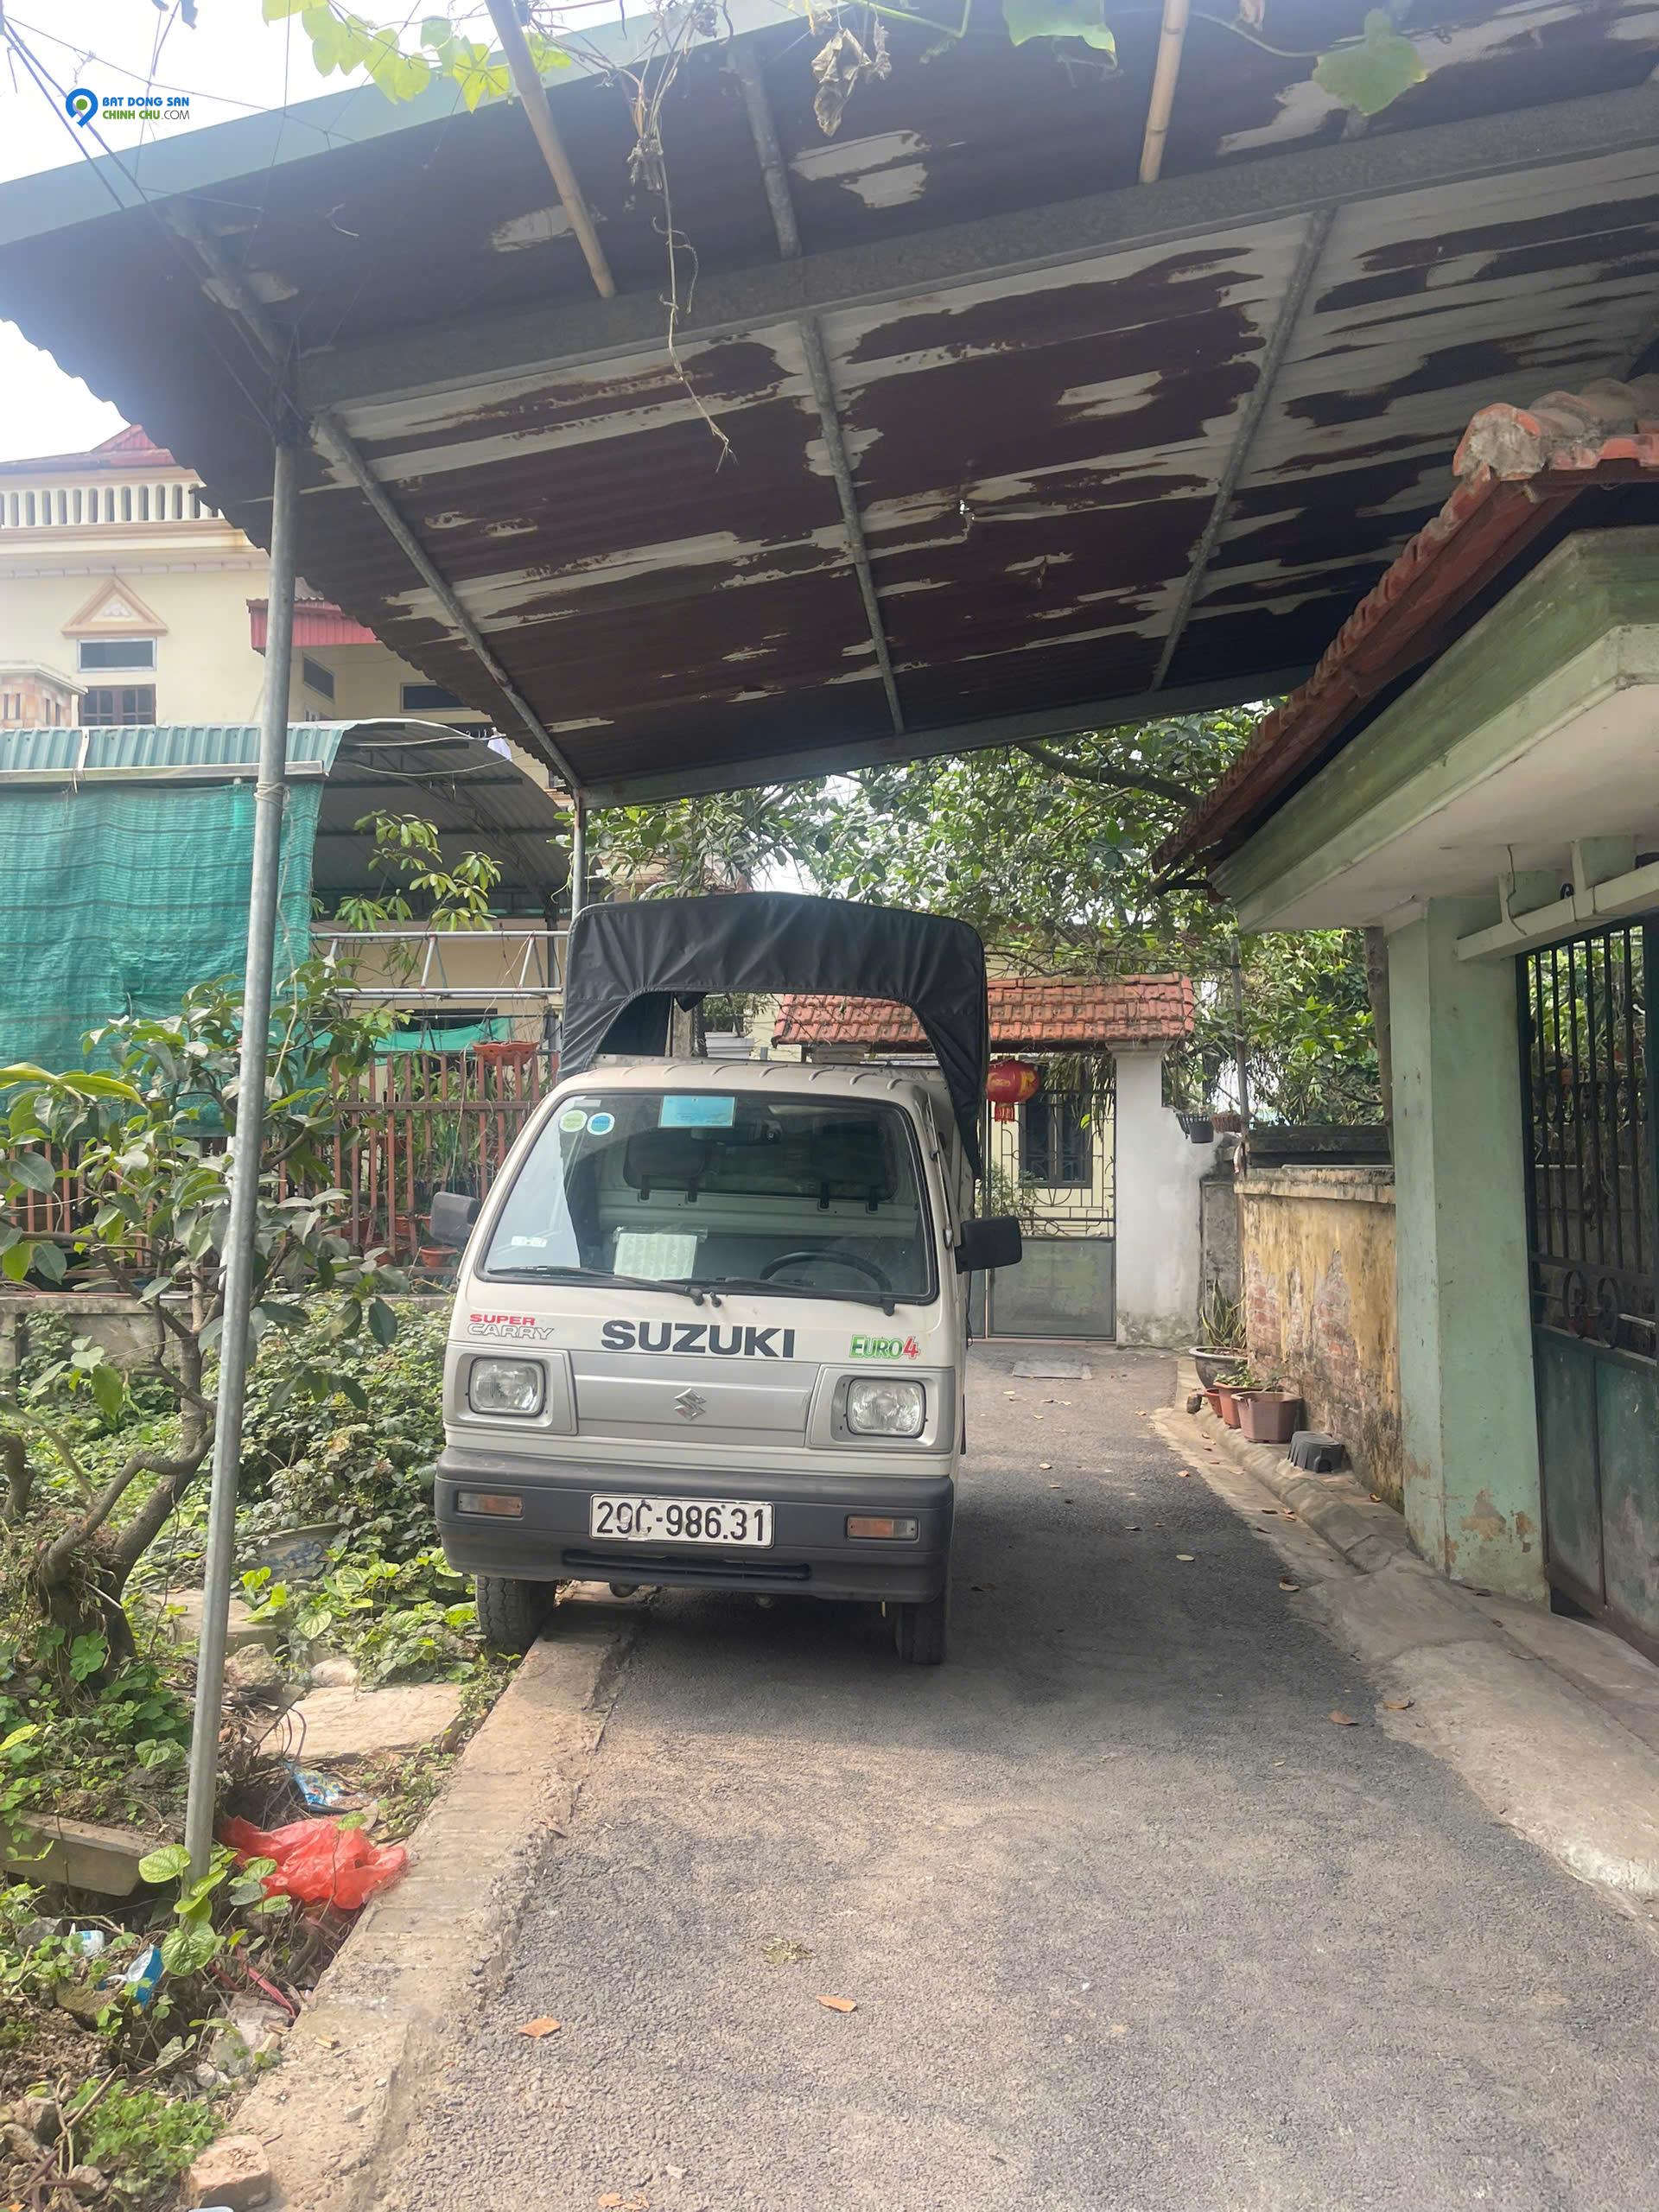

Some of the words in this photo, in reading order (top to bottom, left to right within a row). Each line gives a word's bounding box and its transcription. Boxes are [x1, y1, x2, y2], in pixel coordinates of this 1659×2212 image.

[469, 1313, 536, 1325] SUPER
[467, 1323, 555, 1339] CARRY
[601, 1319, 796, 1358] SUZUKI
